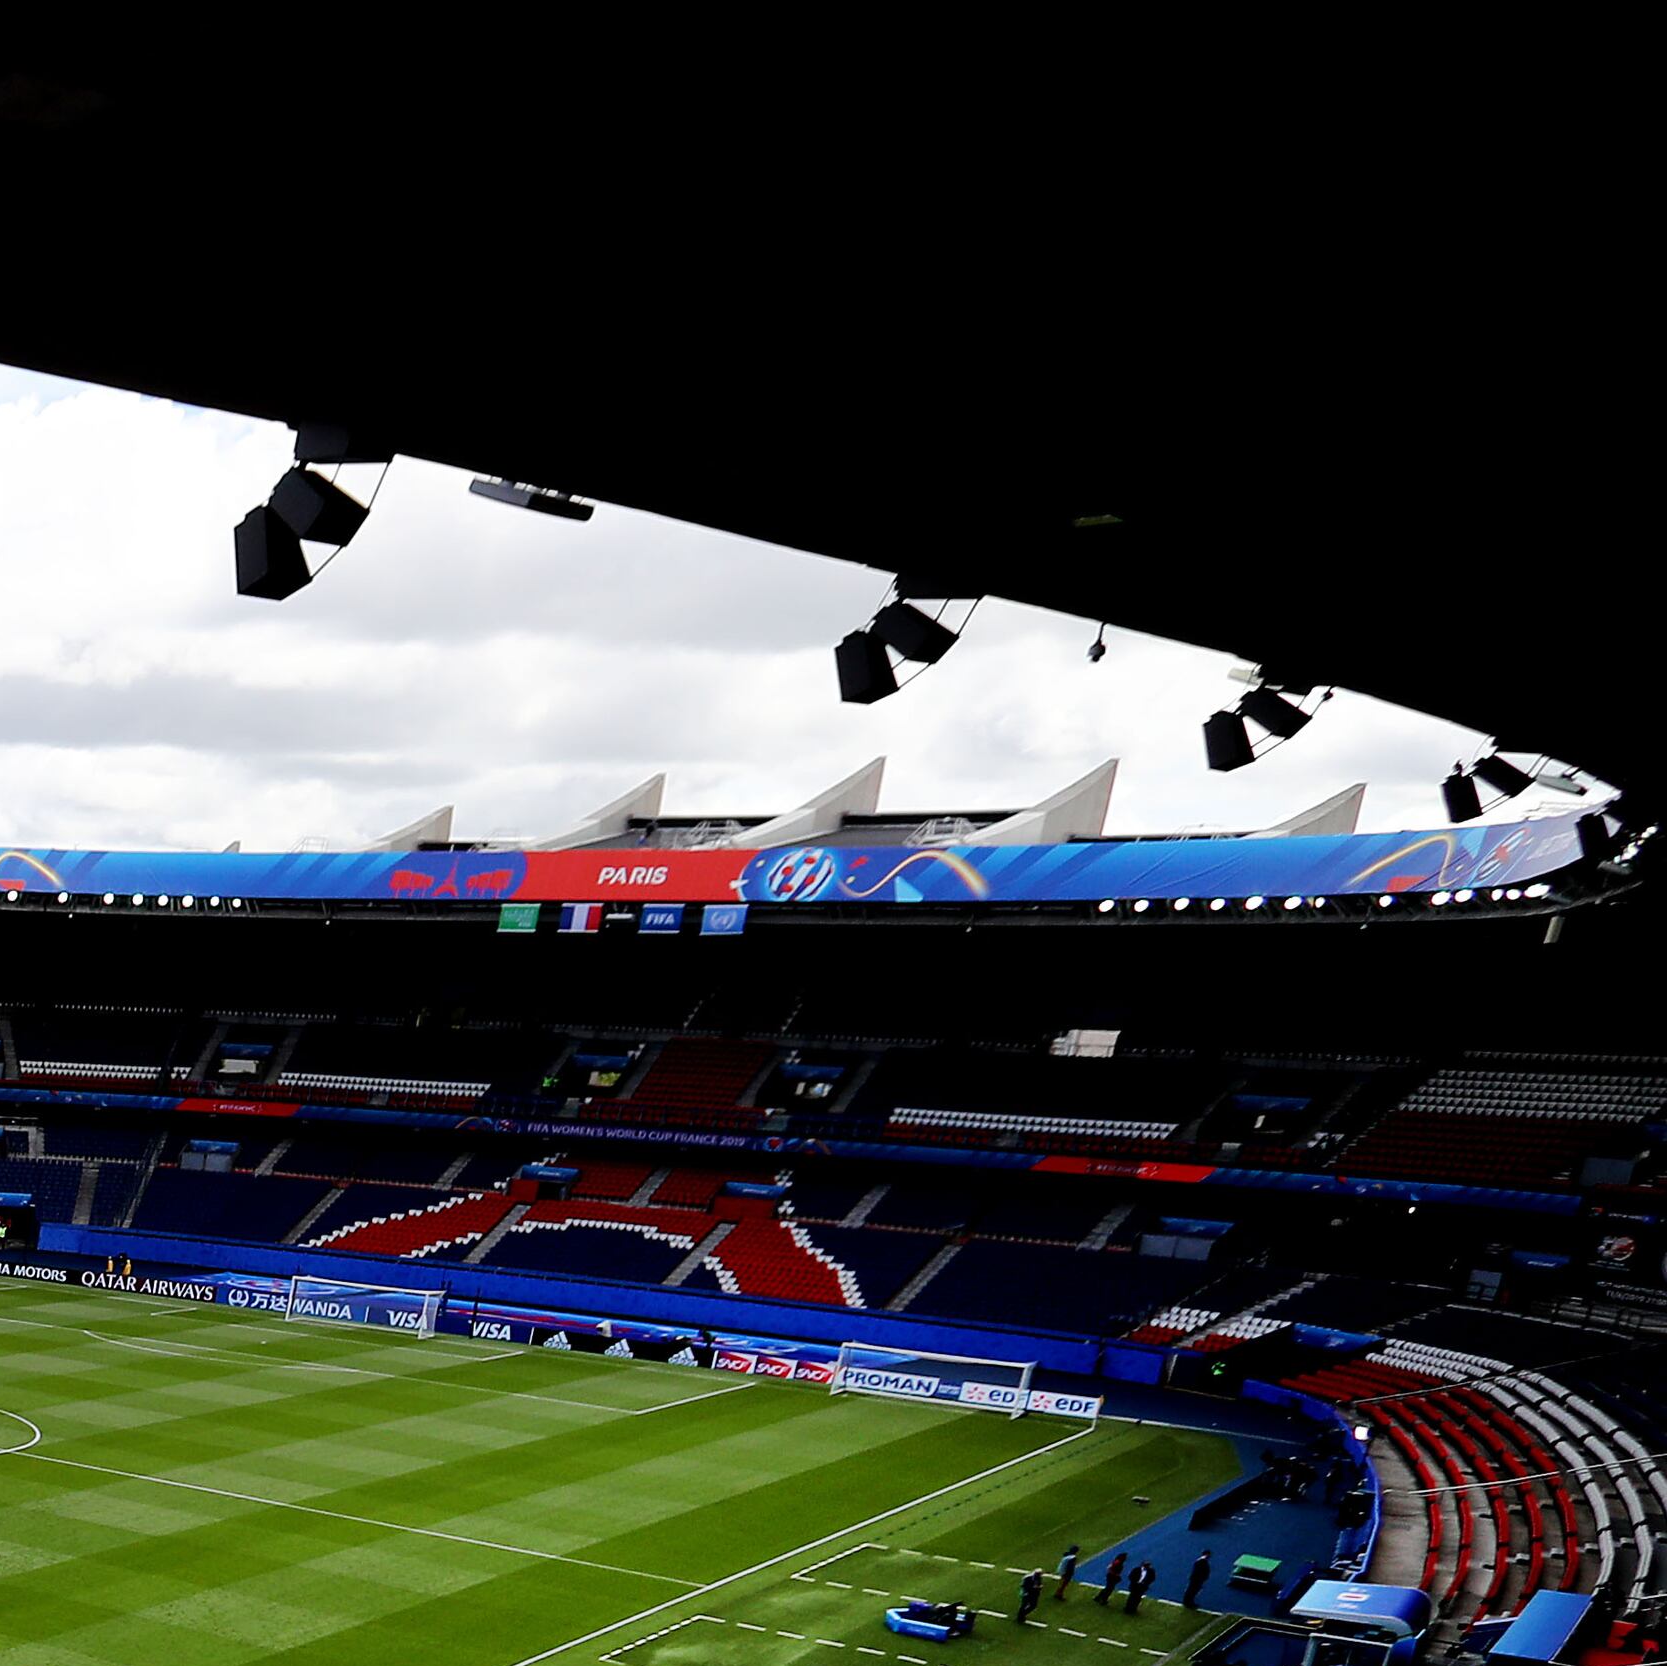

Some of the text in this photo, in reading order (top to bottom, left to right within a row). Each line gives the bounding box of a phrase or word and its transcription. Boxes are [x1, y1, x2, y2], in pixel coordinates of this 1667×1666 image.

[597, 866, 668, 885] PARIS
[645, 912, 675, 926] FIFA
[527, 1122, 549, 1134] FIFA
[606, 1127, 645, 1140] WORLD
[648, 1129, 673, 1142] CUP
[674, 1131, 718, 1146] FRANCE
[13, 1265, 67, 1283] MOTORS
[81, 1270, 214, 1302] QATAR AIRWAYS
[386, 1309, 428, 1330] VISA
[469, 1319, 511, 1341] VISA
[716, 1356, 828, 1381] SNCF SNCF SNCF
[842, 1368, 933, 1394] PROMAN
